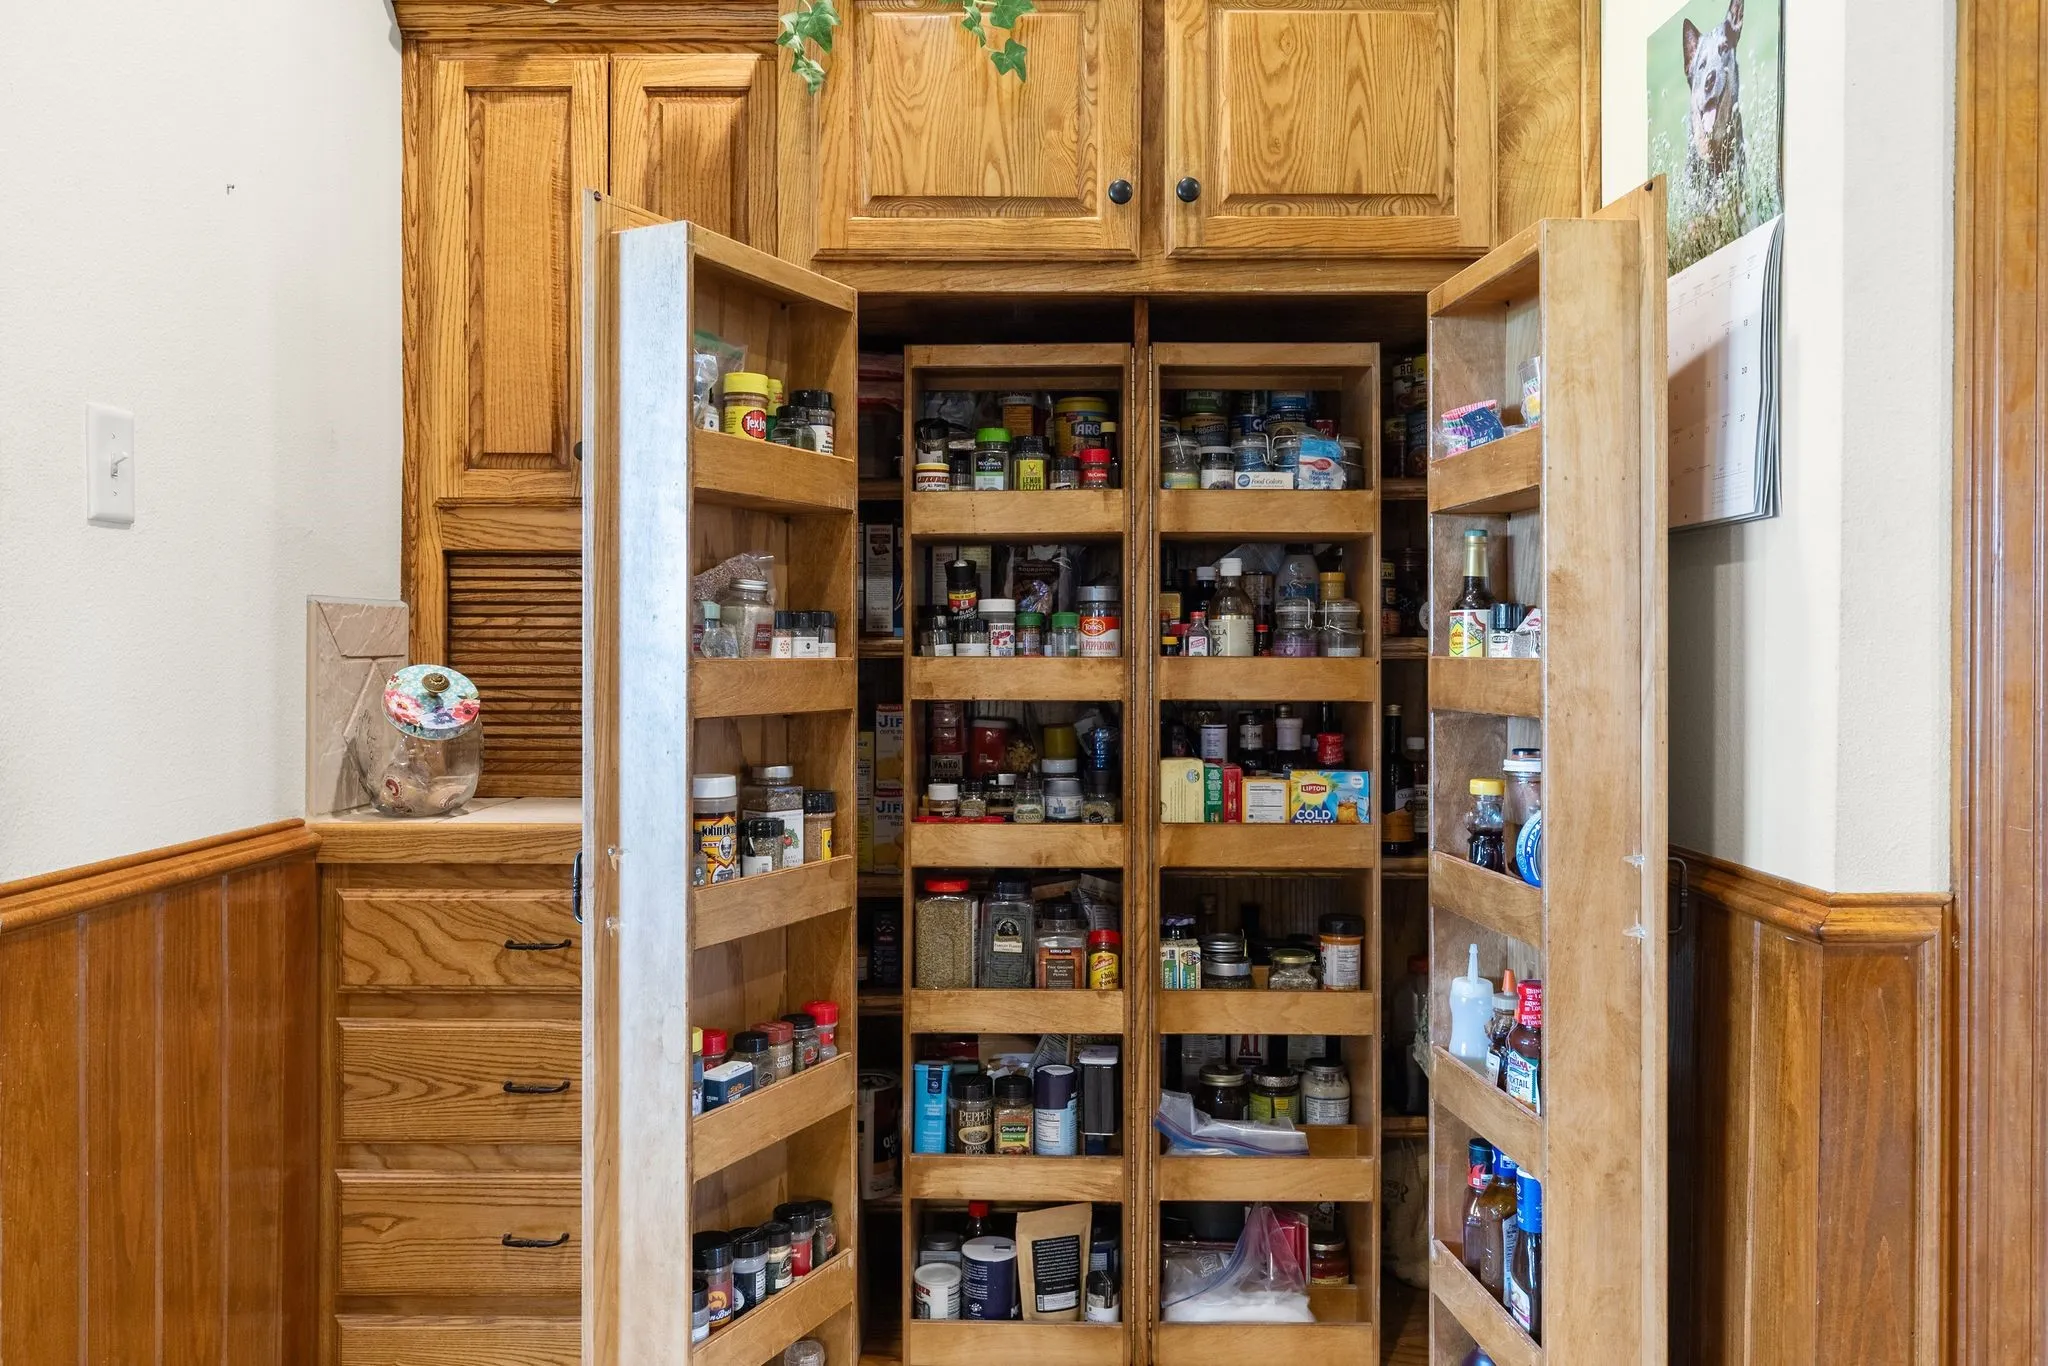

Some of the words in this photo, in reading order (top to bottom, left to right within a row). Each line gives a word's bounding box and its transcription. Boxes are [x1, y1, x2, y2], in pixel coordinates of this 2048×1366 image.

[1075, 423, 1101, 437] ARG
[934, 760, 958, 769] PANKO
[1296, 809, 1331, 820] COLD
[959, 1109, 991, 1121] PEPPER
